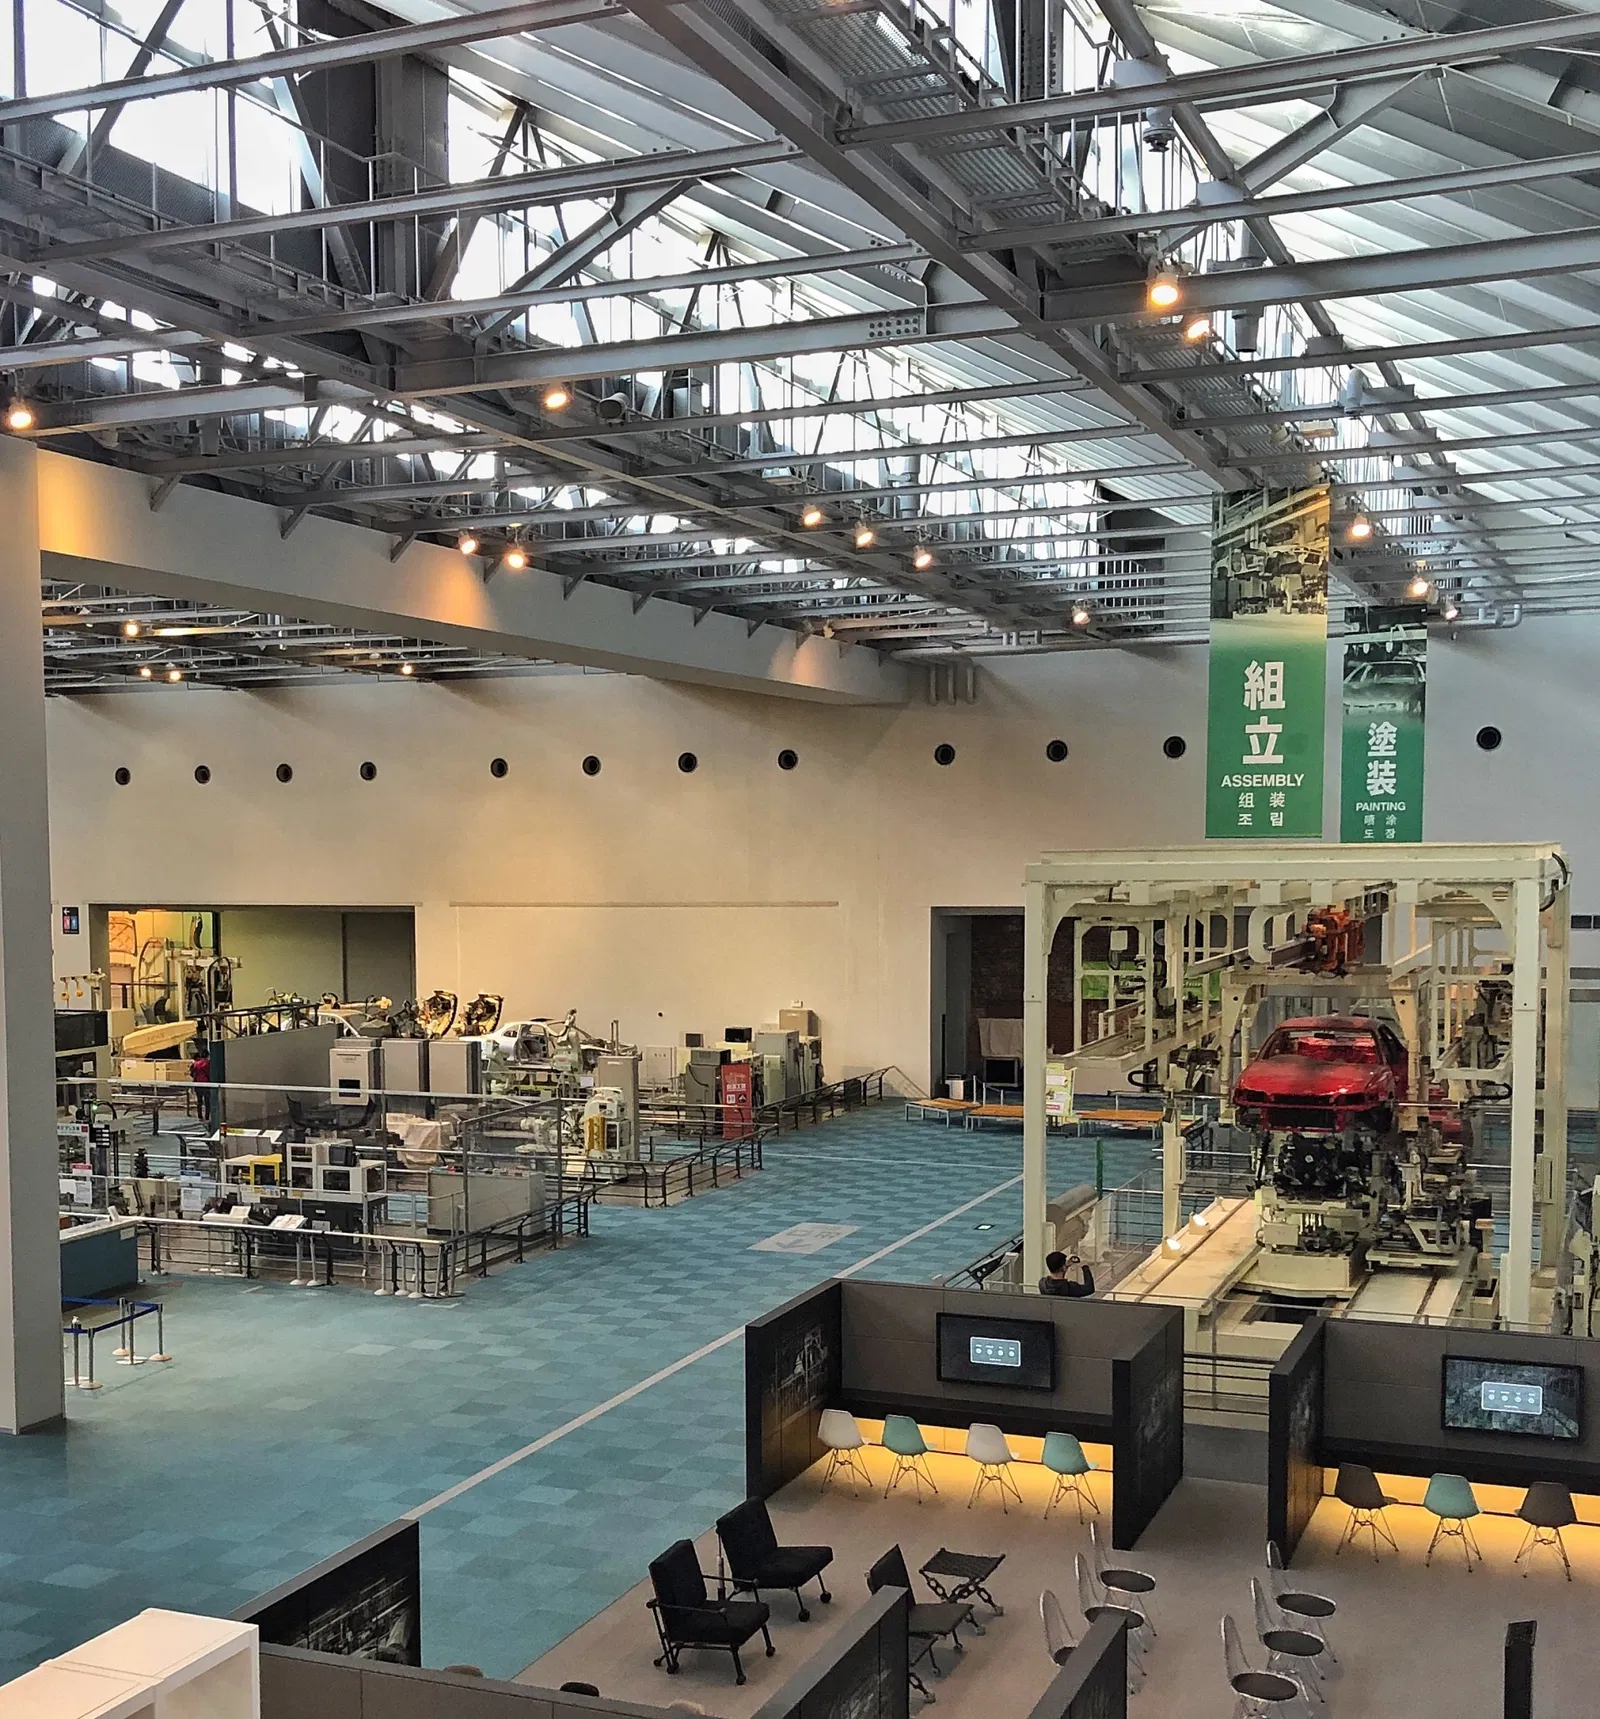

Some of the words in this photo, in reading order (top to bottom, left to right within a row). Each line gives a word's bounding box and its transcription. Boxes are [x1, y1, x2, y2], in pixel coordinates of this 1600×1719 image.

[1243, 661, 1285, 764] 組立
[1367, 721, 1398, 796] 塗装
[1221, 774, 1305, 788] ASSEMBLY
[1356, 802, 1406, 812] PAINTING
